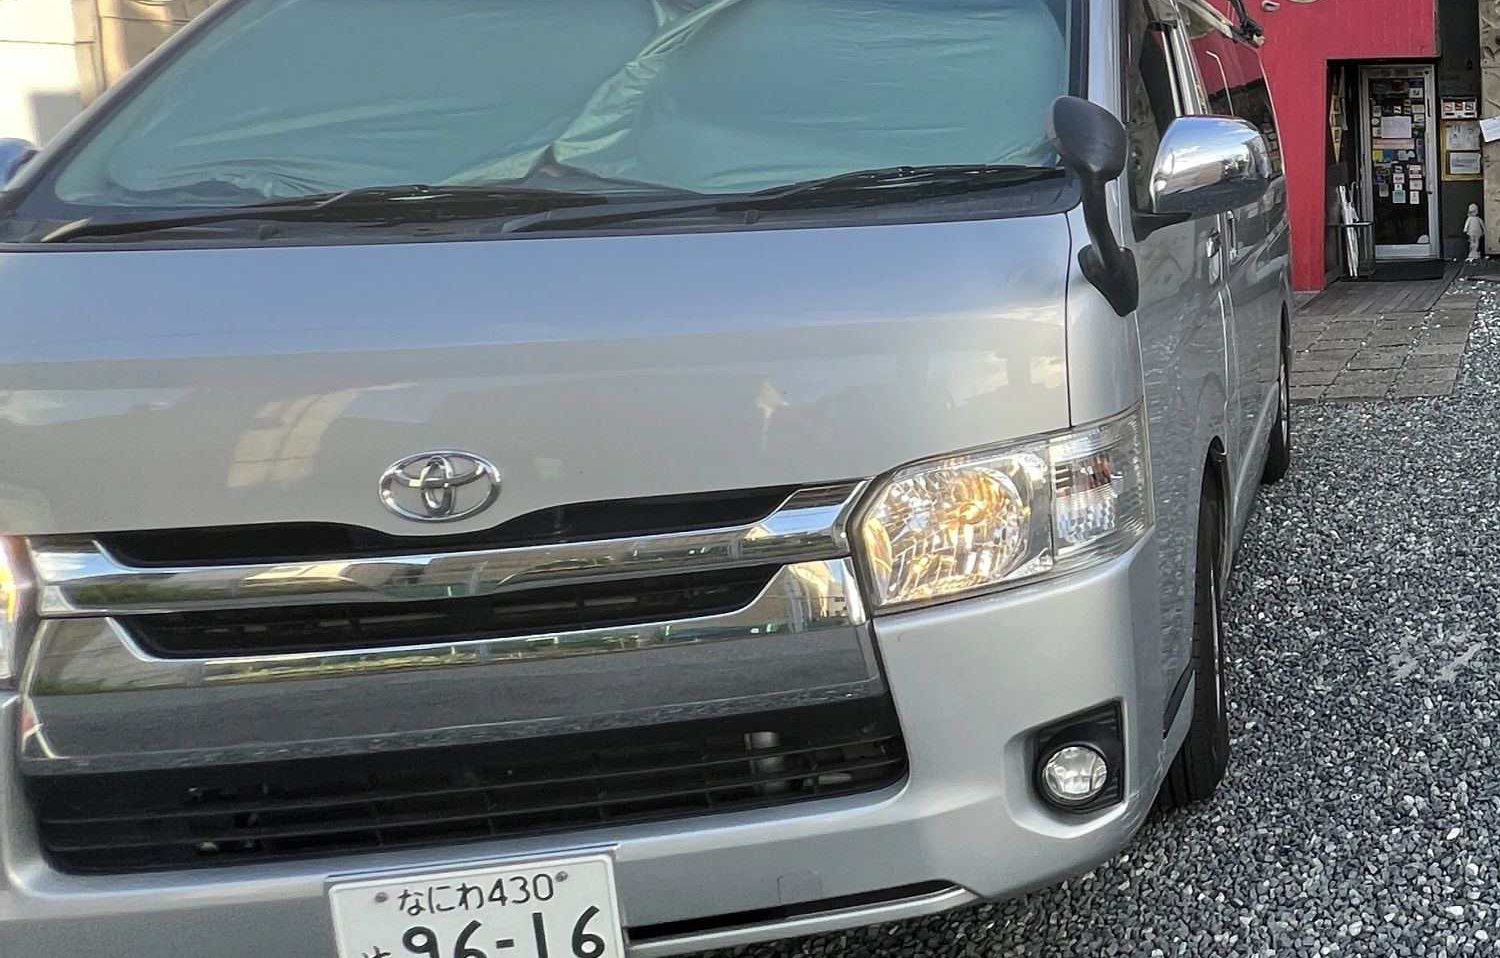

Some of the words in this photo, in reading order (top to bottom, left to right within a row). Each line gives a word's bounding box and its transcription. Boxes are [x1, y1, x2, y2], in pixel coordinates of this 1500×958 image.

[398, 873, 554, 916] なにわ430
[402, 905, 606, 958] 96-16
